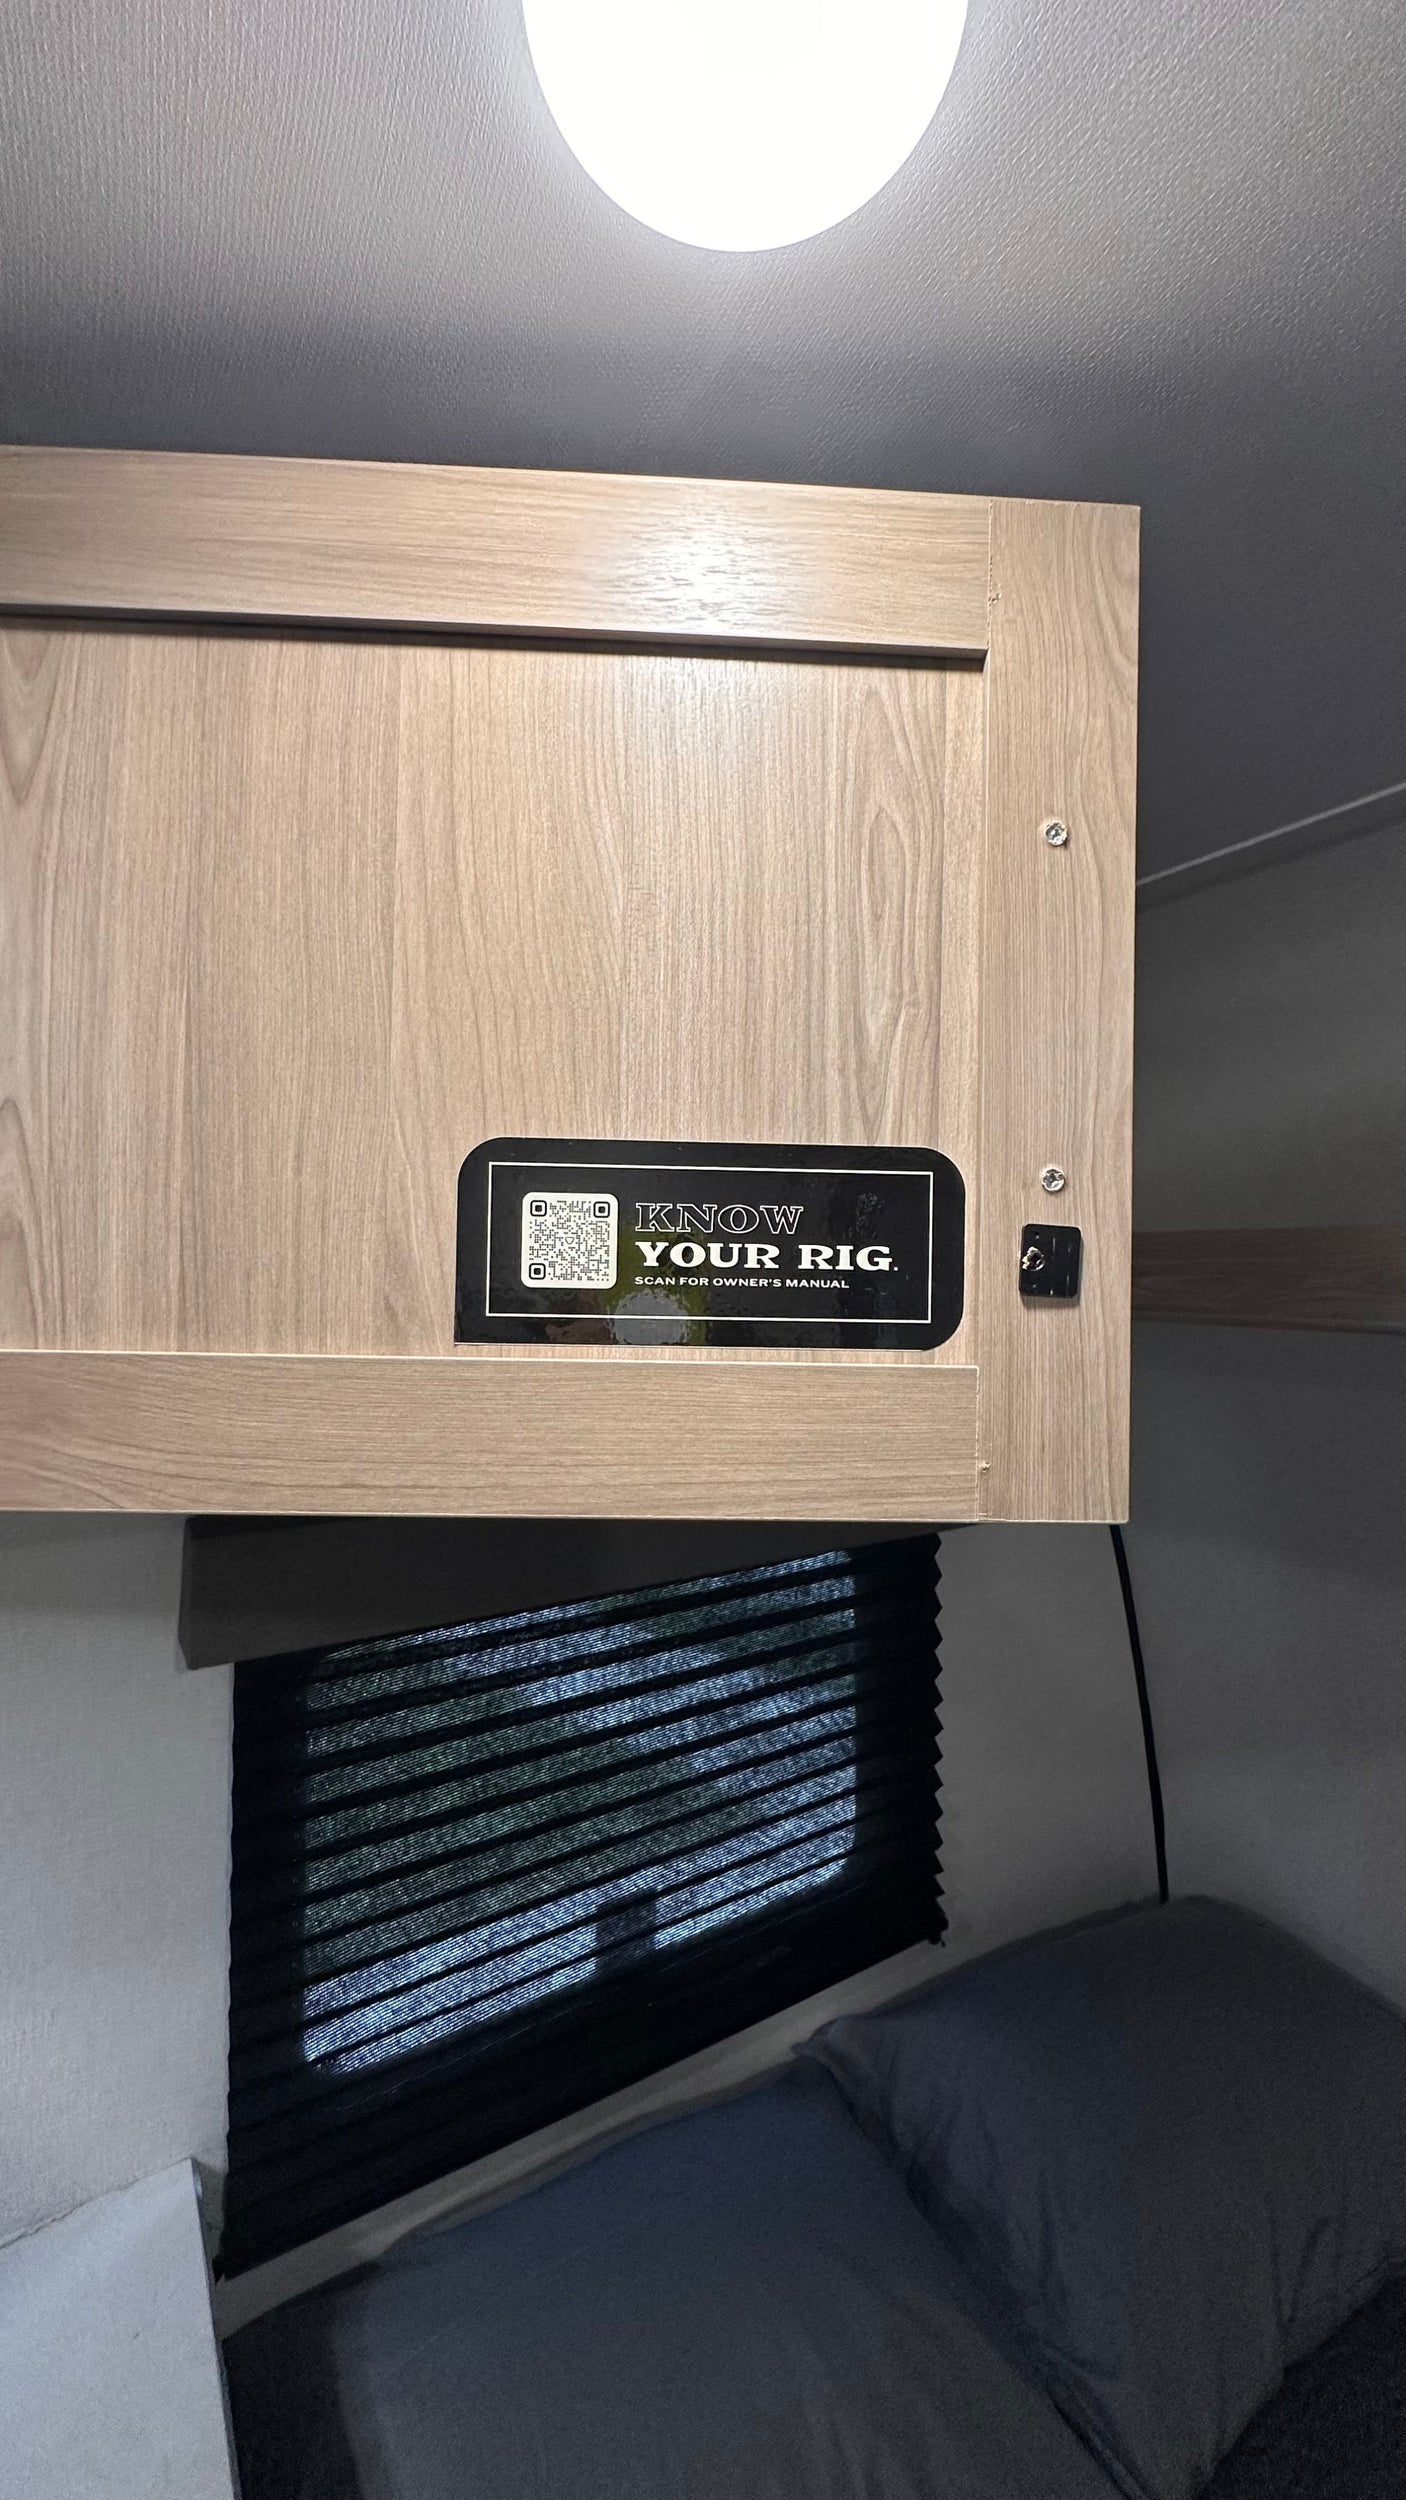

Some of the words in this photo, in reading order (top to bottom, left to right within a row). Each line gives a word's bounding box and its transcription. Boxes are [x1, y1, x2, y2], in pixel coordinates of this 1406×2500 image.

[635, 1202, 804, 1235] KNOW
[635, 1241, 780, 1269] YOUR
[798, 1244, 899, 1272] RIG.
[634, 1276, 676, 1287] SCAN
[679, 1277, 710, 1287] FOR
[713, 1278, 782, 1288] OWNER'S
[785, 1279, 850, 1289] MANUAL
